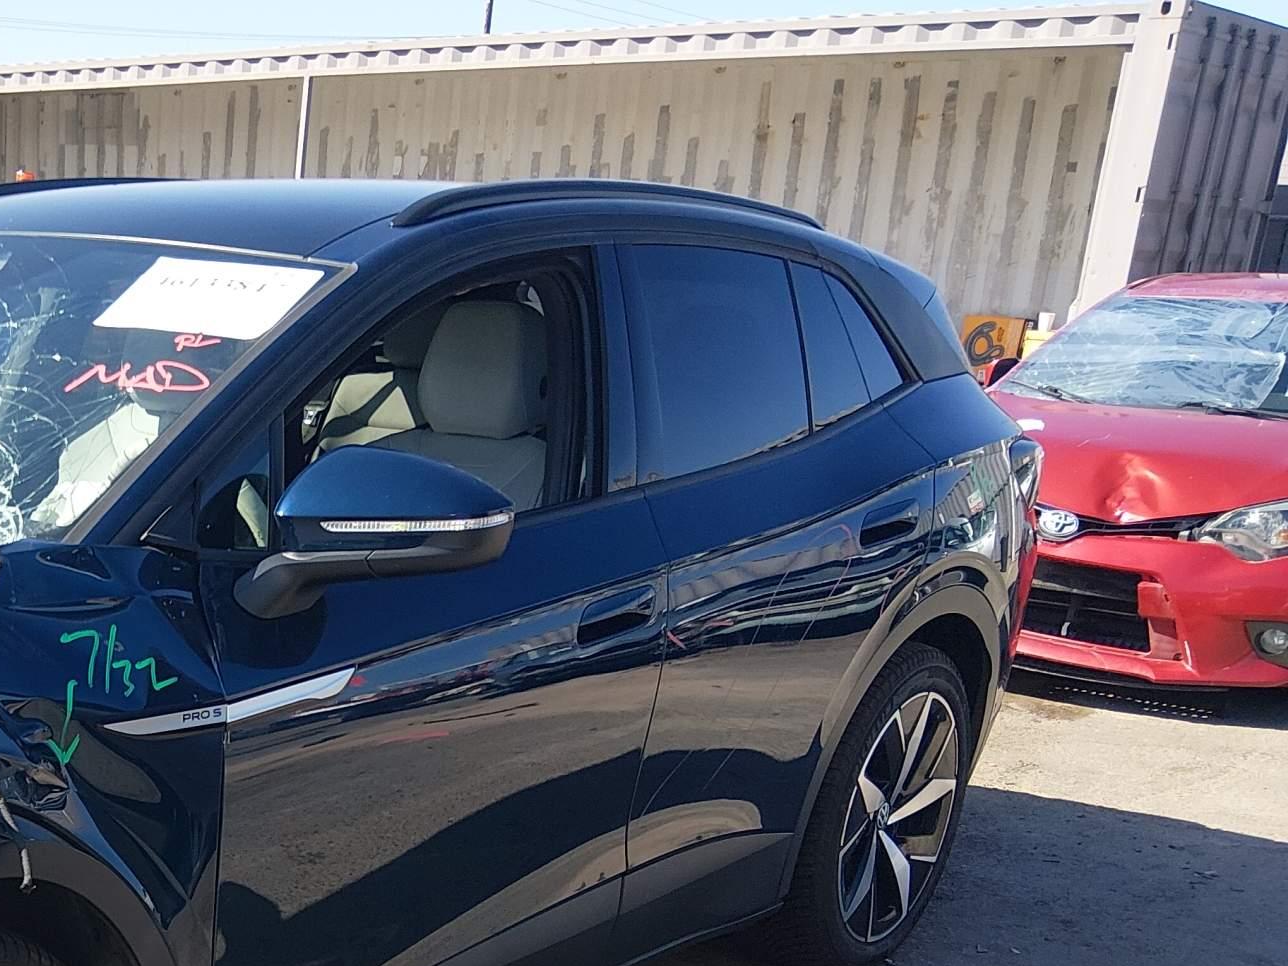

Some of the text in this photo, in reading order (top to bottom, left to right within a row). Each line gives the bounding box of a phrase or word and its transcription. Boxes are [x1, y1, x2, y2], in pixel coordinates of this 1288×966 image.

[60, 624, 178, 697] 7/32
[182, 708, 222, 723] PRO S
